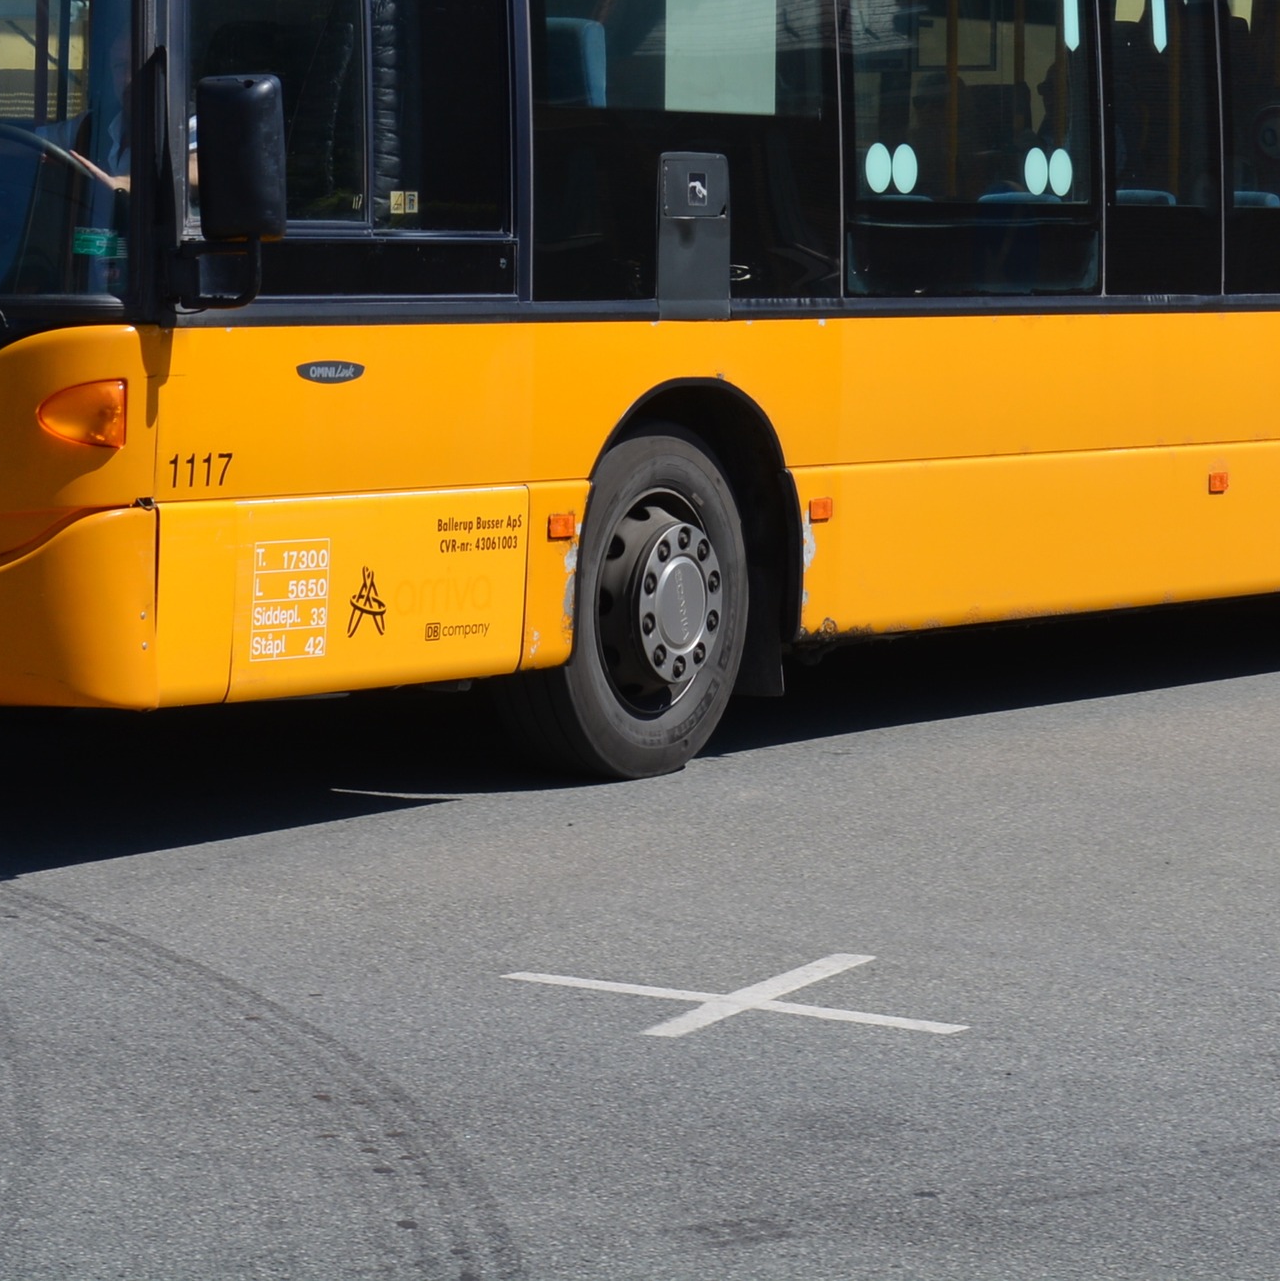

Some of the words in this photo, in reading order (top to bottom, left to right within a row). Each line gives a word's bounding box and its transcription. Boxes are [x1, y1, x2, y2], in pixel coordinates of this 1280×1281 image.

[169, 452, 233, 488] 1117
[437, 517, 473, 534] Ballerup
[476, 516, 504, 530] Busser
[506, 514, 522, 531] ApS
[440, 539, 472, 553] CVR-nr:
[475, 536, 518, 551] 43061003
[256, 548, 267, 566] T.
[283, 549, 328, 570] 17300
[255, 578, 263, 596] L
[288, 579, 327, 598] 5650
[253, 604, 301, 629] Siddepl.
[310, 607, 326, 626] 33
[426, 624, 440, 640] DB
[442, 623, 490, 639] company
[252, 633, 286, 658] Ståpl
[304, 636, 324, 655] 42
